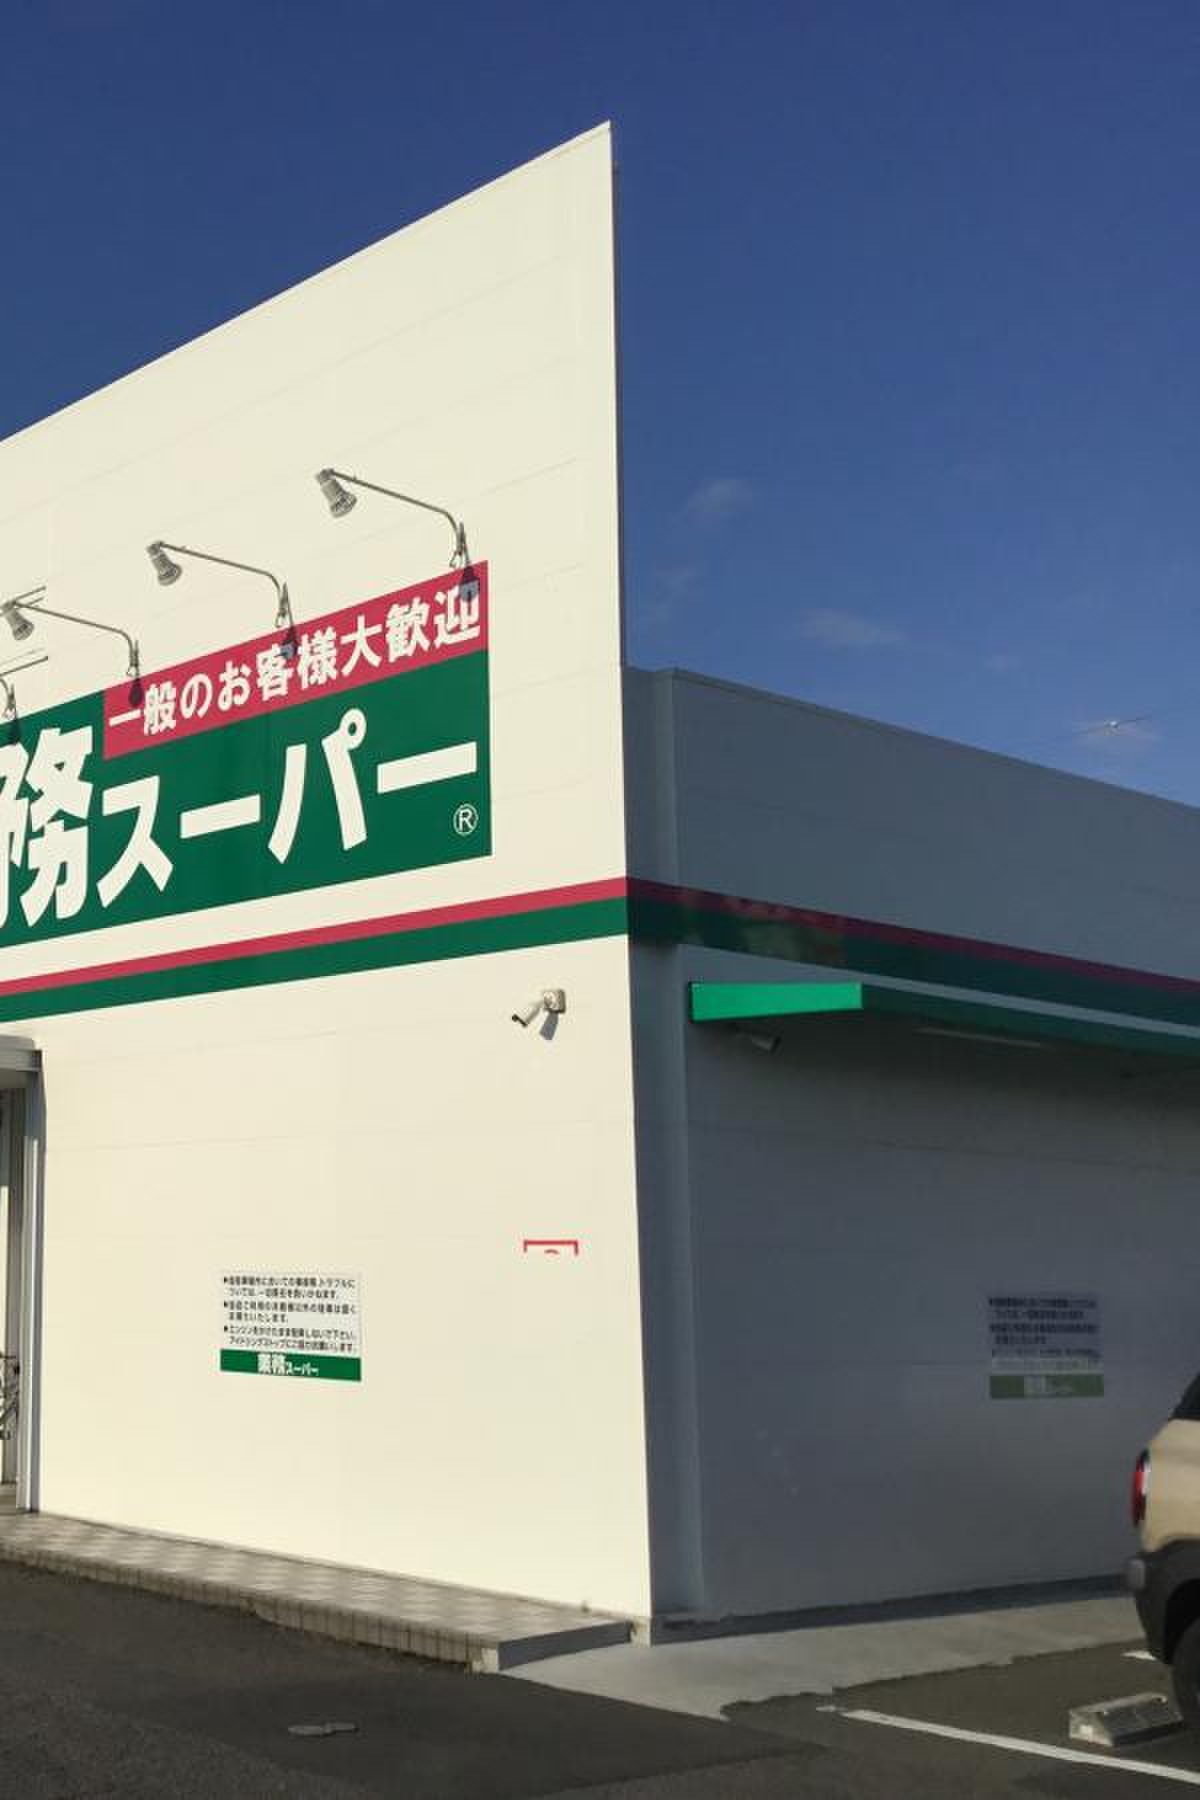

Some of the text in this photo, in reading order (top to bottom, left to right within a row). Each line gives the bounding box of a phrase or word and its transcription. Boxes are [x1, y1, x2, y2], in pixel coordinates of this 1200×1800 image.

[108, 584, 481, 736] 一般のお客様大歓迎
